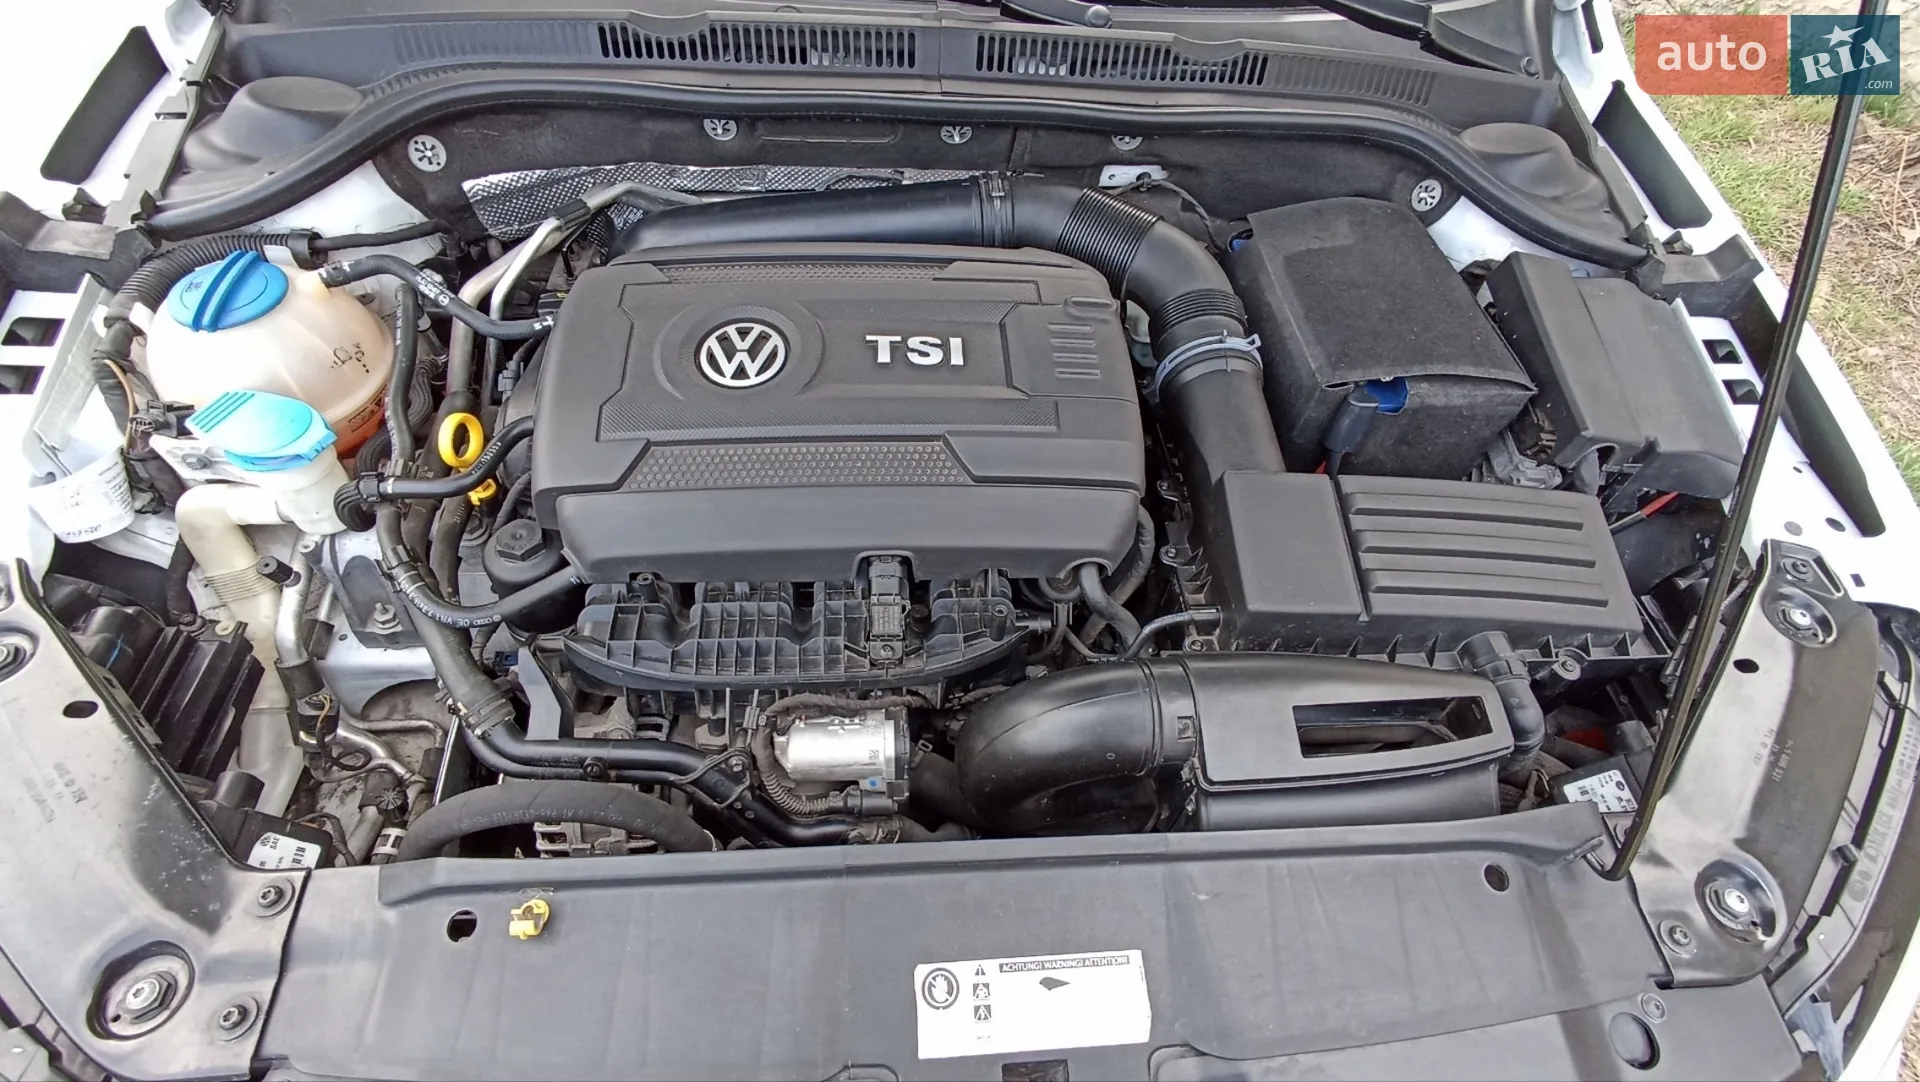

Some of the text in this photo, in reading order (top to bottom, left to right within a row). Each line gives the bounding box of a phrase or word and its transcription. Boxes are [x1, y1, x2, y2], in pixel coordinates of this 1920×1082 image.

[865, 334, 965, 367] TSI
[1001, 955, 1129, 973] ACHTUNG! WARNING! ATTENTION!
